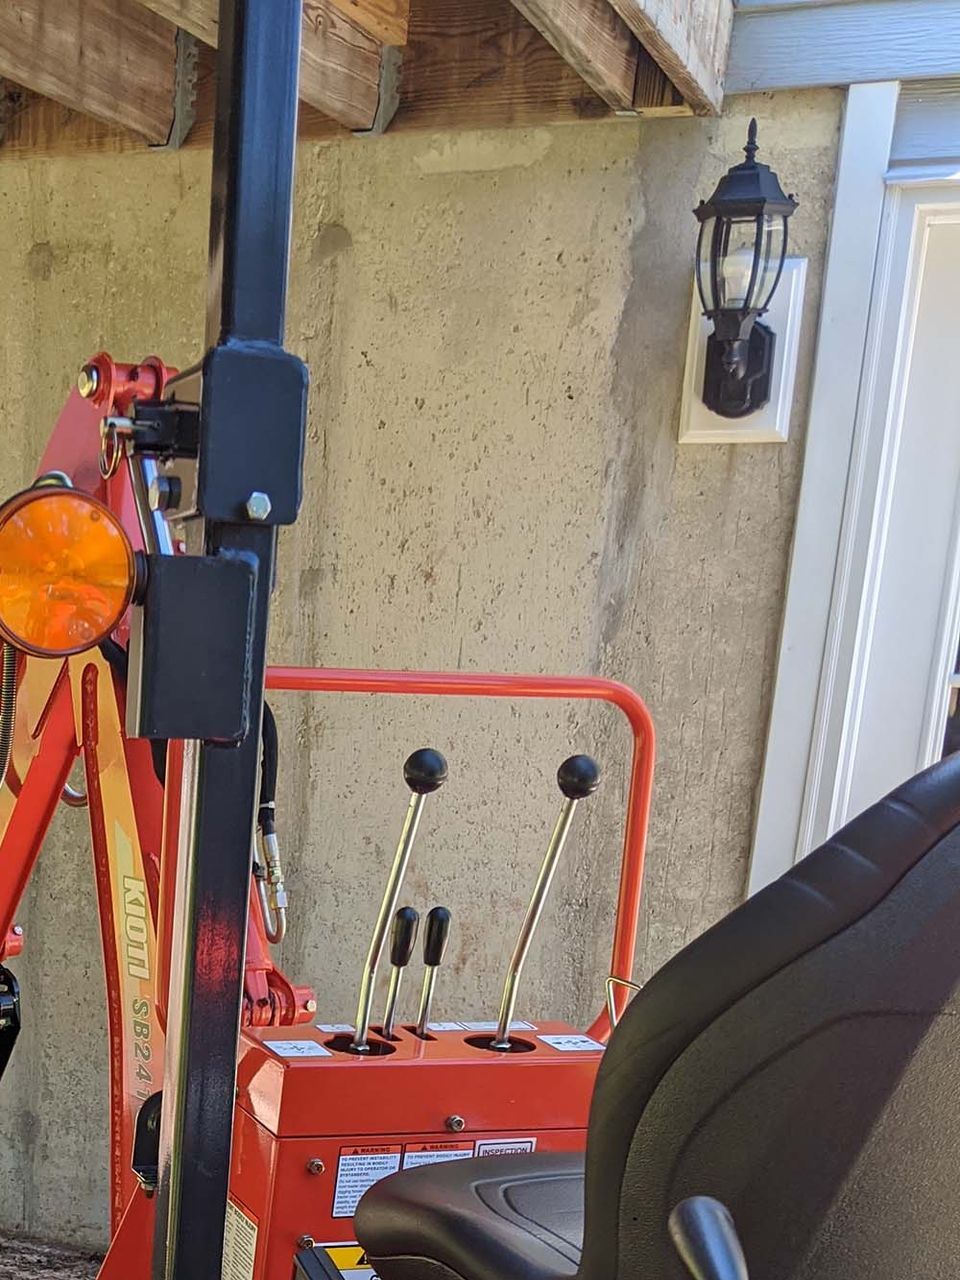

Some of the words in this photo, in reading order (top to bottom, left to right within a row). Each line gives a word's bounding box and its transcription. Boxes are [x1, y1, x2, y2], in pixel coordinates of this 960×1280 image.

[123, 875, 149, 980] KIOTI
[132, 998, 152, 1102] SB241
[483, 1147, 527, 1156] INSPECTION
